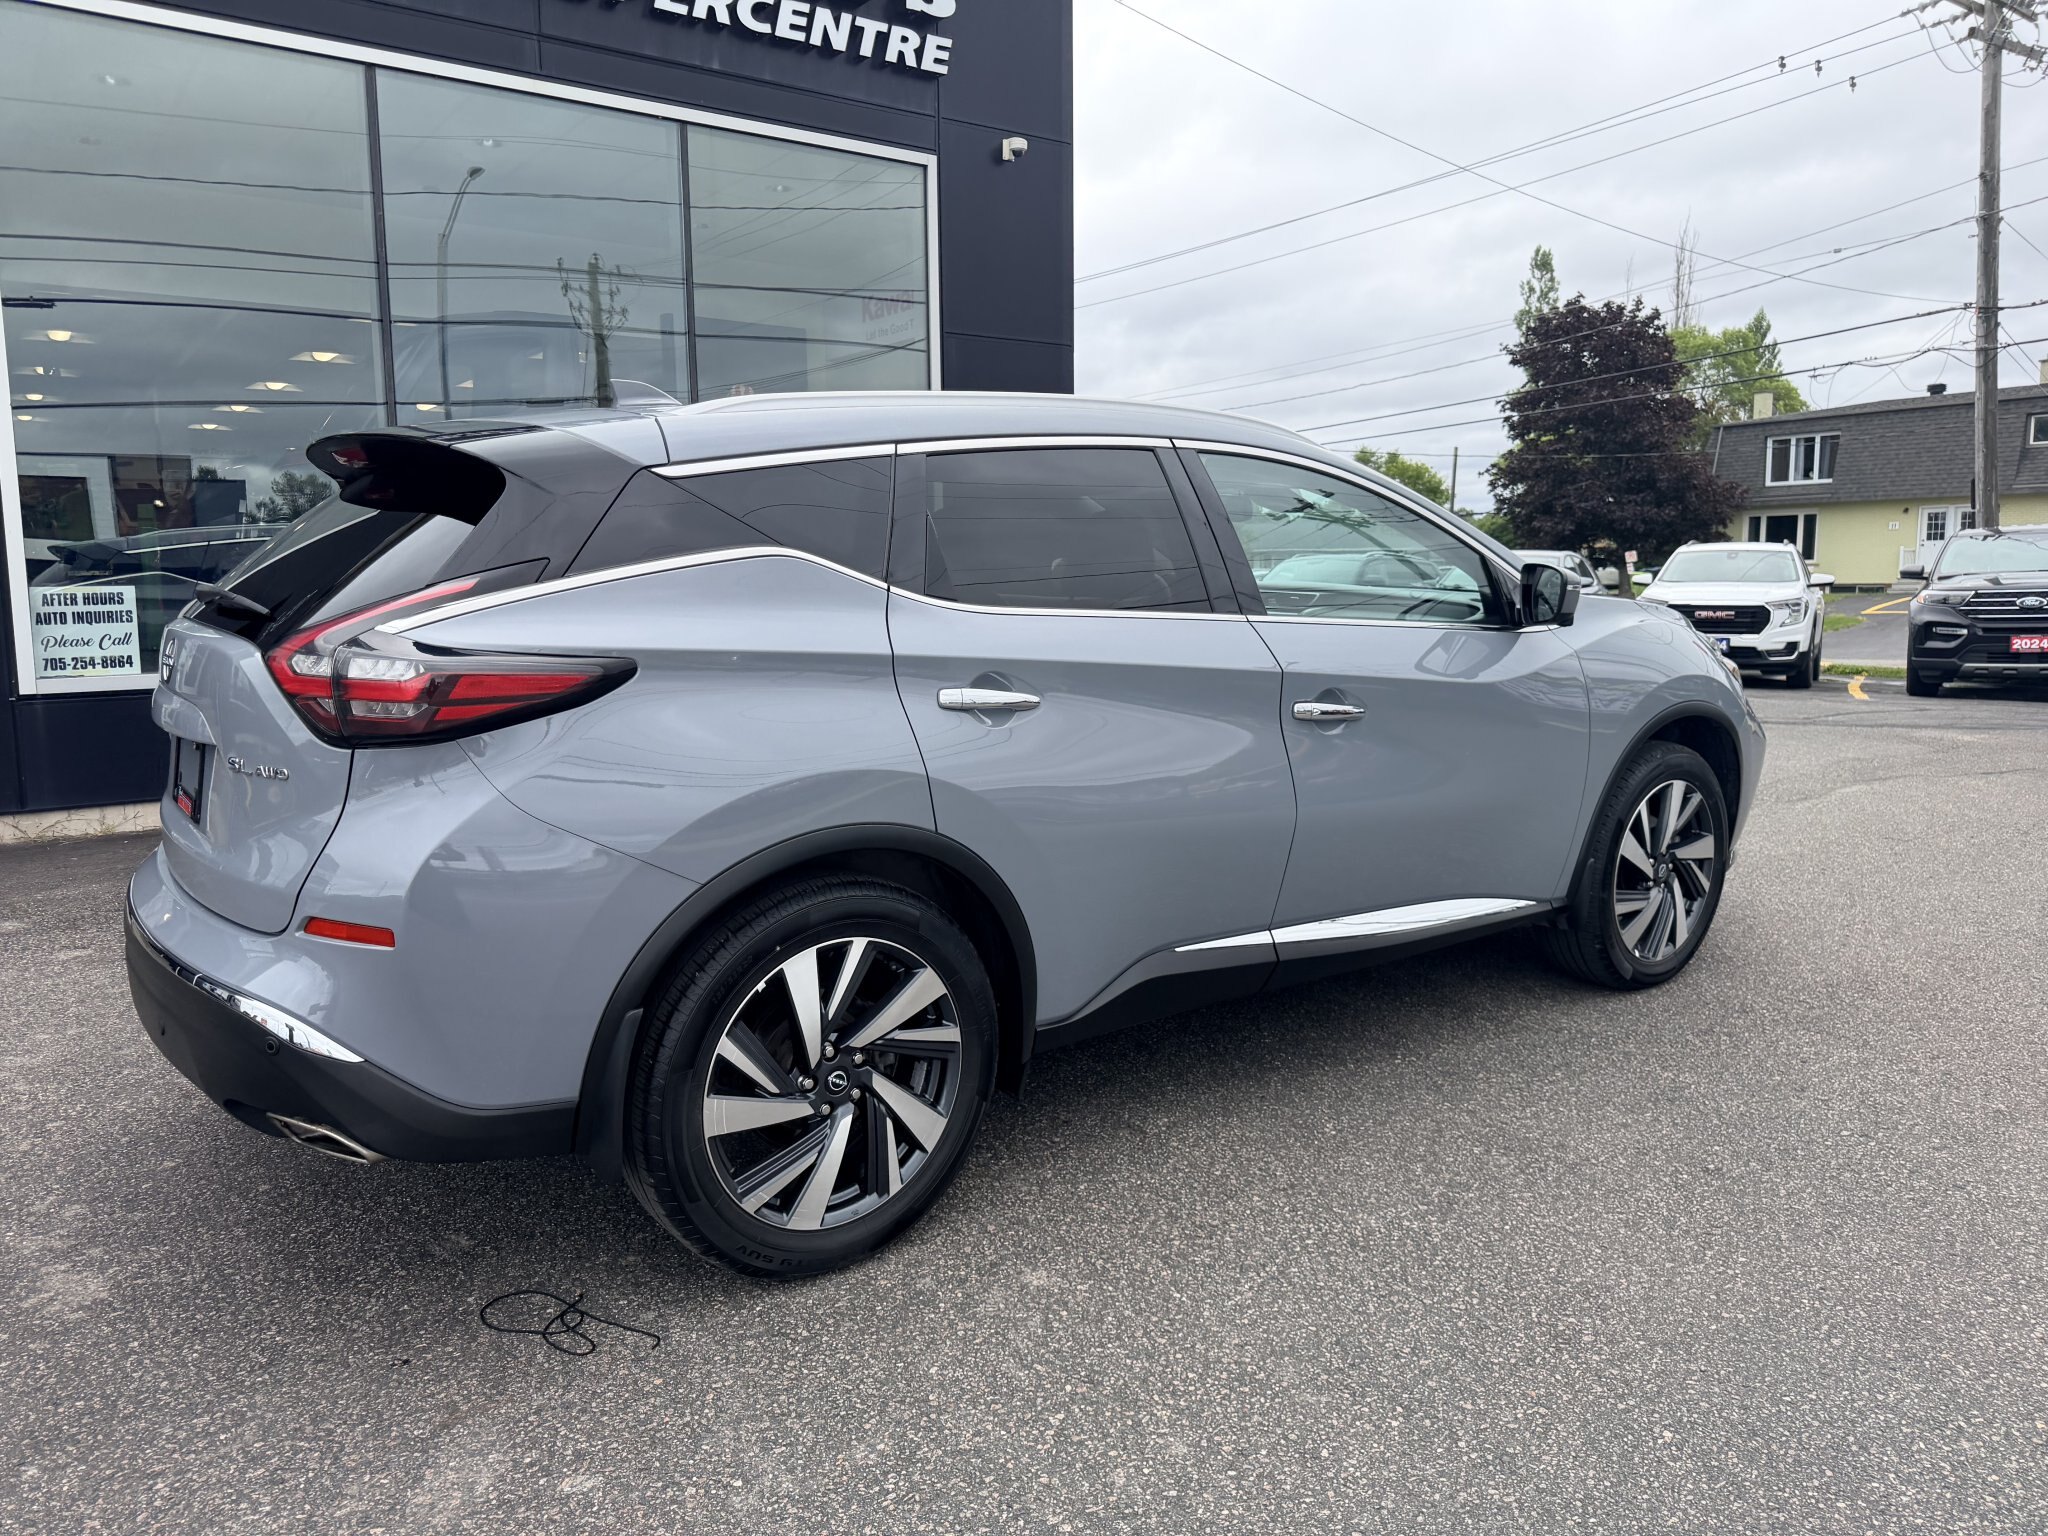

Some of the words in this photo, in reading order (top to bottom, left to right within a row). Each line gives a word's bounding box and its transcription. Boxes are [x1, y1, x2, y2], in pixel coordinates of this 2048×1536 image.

[42, 593, 78, 607] AFTER
[82, 592, 125, 606] HOURS
[35, 612, 68, 626] AUTO
[72, 610, 134, 625] INQUIRIES
[1694, 610, 1735, 619] GMC
[41, 634, 95, 652] Please
[99, 632, 133, 650] Call
[2012, 638, 2048, 649] 2024
[42, 655, 134, 671] 705-254-8864
[228, 756, 253, 776] SL
[255, 764, 289, 780] AWD
